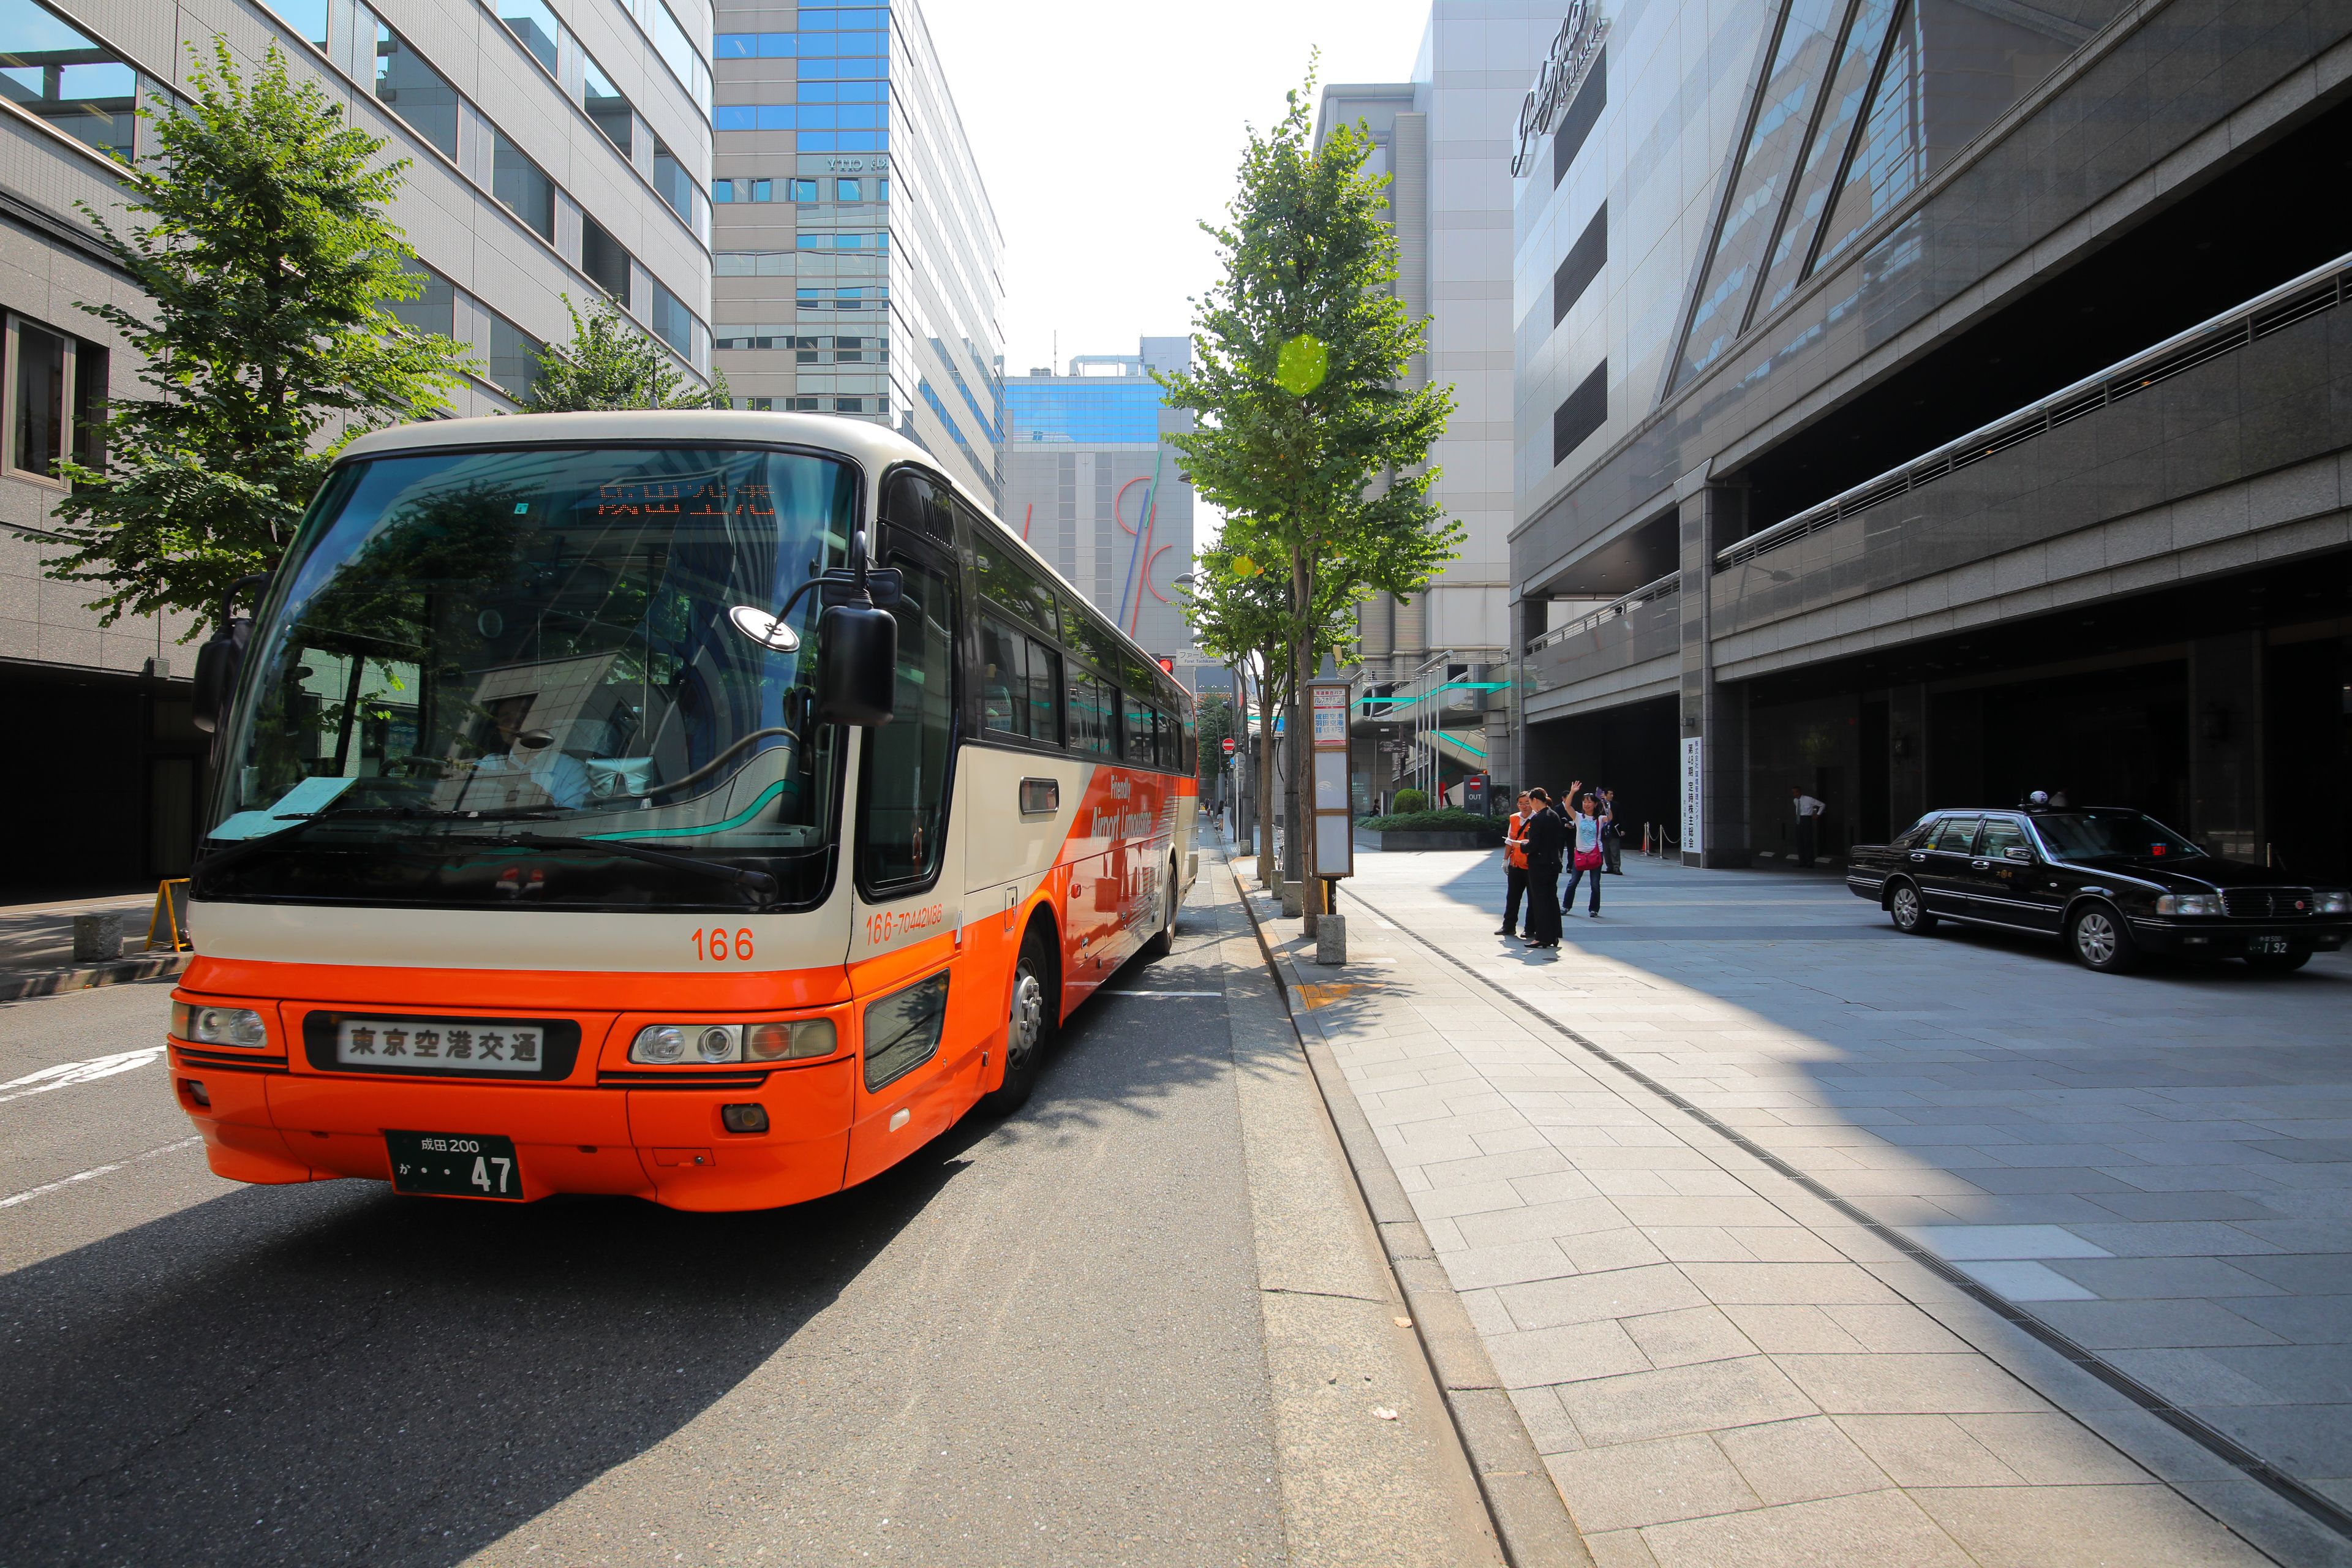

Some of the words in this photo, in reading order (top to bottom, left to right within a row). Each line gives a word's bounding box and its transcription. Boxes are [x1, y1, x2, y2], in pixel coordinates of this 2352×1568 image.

[1556, 17, 1603, 109] TACHIKAWA
[1111, 775, 1131, 802] Friendly
[1091, 806, 1120, 843] Airport
[1120, 804, 1152, 839] Limousine
[867, 903, 943, 946] 166-70442M86
[692, 927, 754, 961] 166
[349, 1027, 537, 1062] 東京空港交通
[472, 1156, 511, 1193] 47
